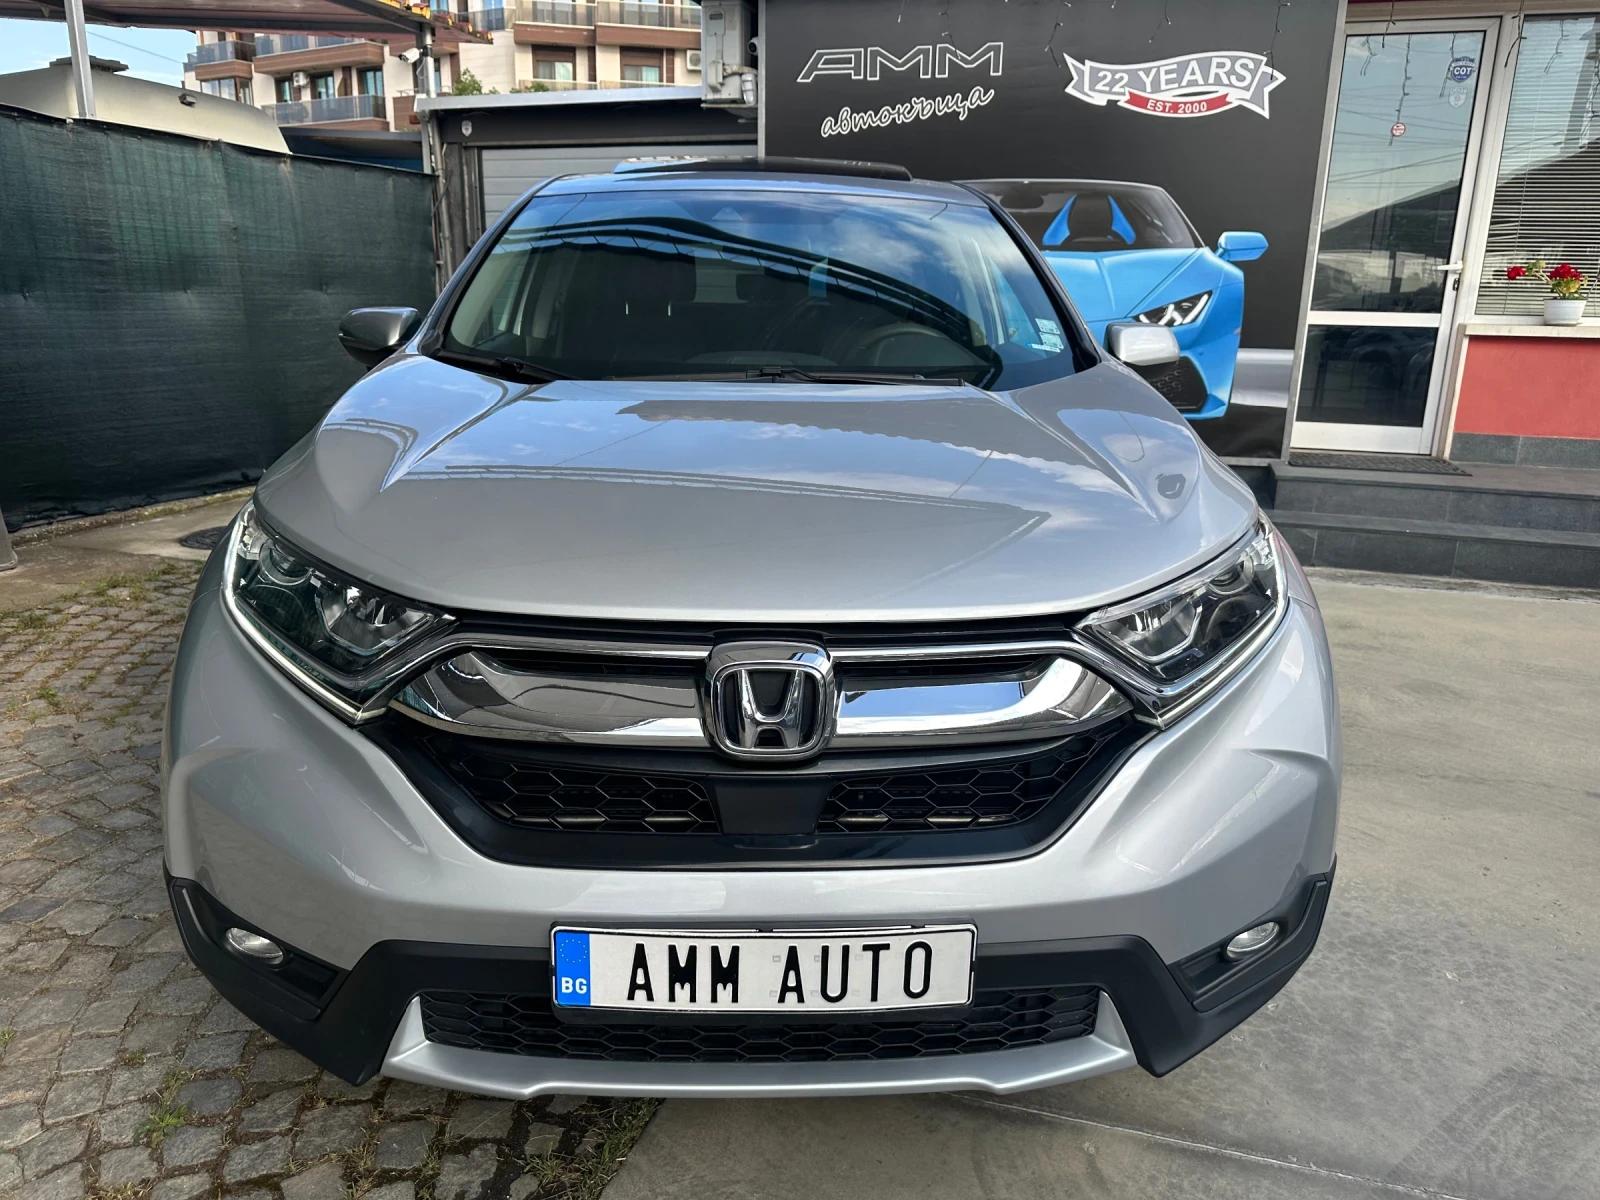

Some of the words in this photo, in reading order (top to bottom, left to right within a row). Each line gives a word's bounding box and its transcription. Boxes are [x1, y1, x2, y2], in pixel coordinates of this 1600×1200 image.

[797, 42, 1004, 83] AMM
[1094, 70, 1129, 92] 22
[1137, 56, 1255, 93] YEARS
[820, 86, 995, 138] автокъща
[1146, 99, 1174, 113] EST.
[1177, 102, 1208, 115] 2000
[561, 976, 588, 994] BG
[626, 943, 740, 1003] AMM
[777, 940, 933, 1003] AUTO
